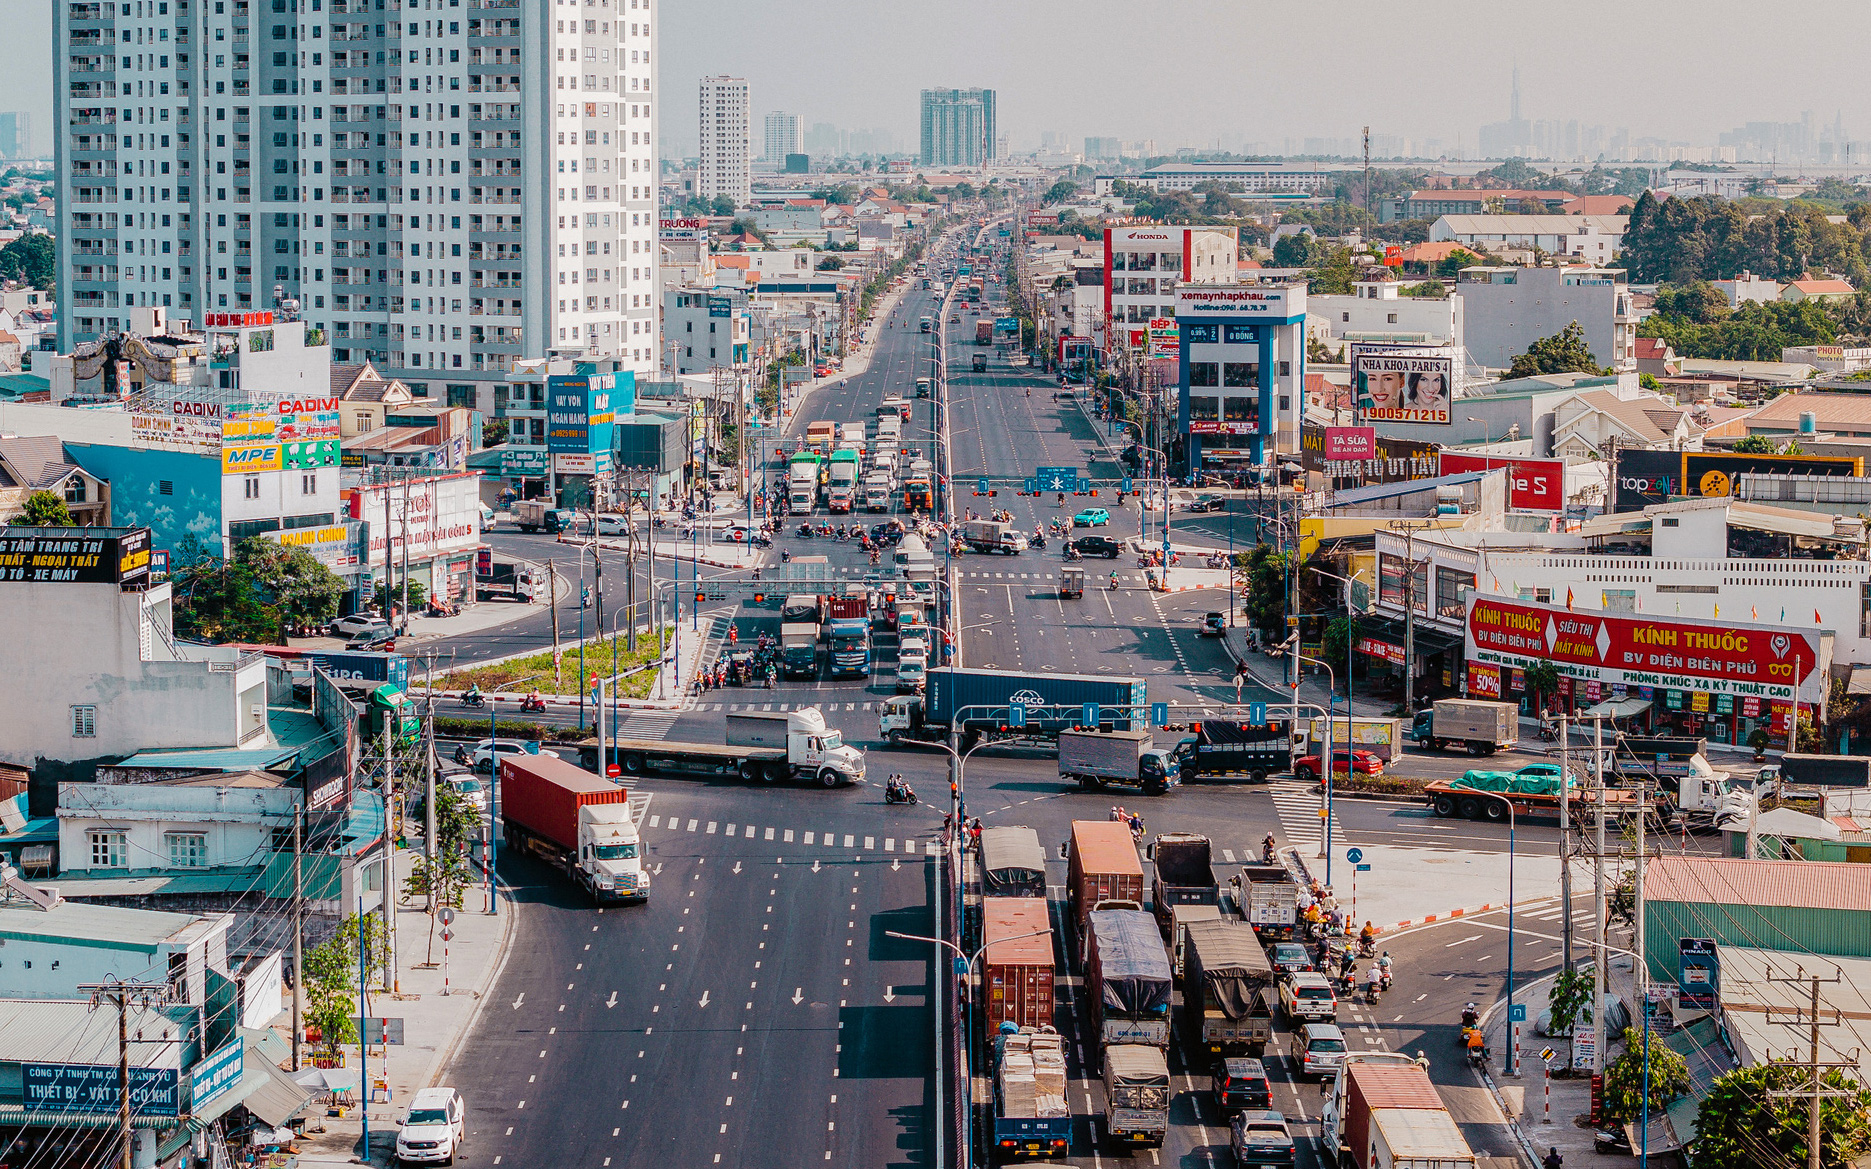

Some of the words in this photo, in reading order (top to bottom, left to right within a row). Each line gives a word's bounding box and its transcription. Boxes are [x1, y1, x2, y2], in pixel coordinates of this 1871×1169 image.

[1181, 291, 1281, 302] xemaynhapkhau.com
[1151, 317, 1170, 329] BẾP
[1236, 331, 1254, 340] ĐỒNG
[1817, 346, 1843, 355] PHOTO
[1362, 360, 1382, 370] NHA
[1384, 360, 1409, 371] KHOA
[1412, 361, 1441, 372] PARI'S
[1442, 362, 1448, 372] 4
[588, 376, 601, 391] VAY
[602, 373, 616, 390] TIỀN
[279, 397, 340, 414] CADIVI
[556, 395, 566, 407] VAY
[173, 401, 220, 418] CADIVI
[550, 410, 568, 424] NGÂN
[1361, 407, 1447, 421] 1900571215
[132, 416, 152, 430] DOANH
[1303, 429, 1323, 451] MẮT
[1332, 435, 1345, 445] TÃ
[1347, 433, 1368, 445] SỮA
[228, 447, 279, 464] MPE
[281, 530, 315, 547] DOANH
[317, 525, 347, 543] CHÍNH
[447, 523, 465, 539] GÒN
[466, 524, 472, 535] 5
[10, 540, 36, 553] TÂM
[38, 541, 80, 553] TRANG
[83, 540, 104, 553] TRÍ
[0, 553, 26, 567] THẤT
[32, 554, 66, 569] NGOẠI
[70, 553, 100, 567] THẤT
[10, 567, 25, 580] TÔ
[34, 569, 50, 580] XE
[51, 567, 79, 581] MÁY
[1475, 605, 1501, 626] KÍNH
[1503, 611, 1542, 633] THUỐC
[1558, 619, 1578, 634] SIÊU
[1579, 622, 1594, 639] THỊ
[1478, 629, 1489, 642] BV
[1490, 630, 1507, 646] ĐIỆN
[1508, 633, 1525, 648] BIÊN
[1527, 635, 1542, 651] PHỦ
[1554, 637, 1573, 654] MẮT
[1573, 641, 1595, 657] KÍNH
[1633, 625, 1678, 647] KÍNH
[1683, 630, 1749, 653] THUỐC
[1477, 651, 1501, 662] CHUYÊN
[1501, 656, 1512, 665] GIA
[1513, 656, 1529, 667] KÍNH
[1578, 667, 1585, 677] SỈ
[1585, 670, 1591, 678] &
[1591, 667, 1600, 679] LẺ
[1623, 652, 1644, 664] BV
[1649, 653, 1683, 670] ĐIỆN
[1687, 657, 1722, 671] BIÊN
[1726, 659, 1758, 675] PHỦ
[1476, 674, 1499, 693] 50%
[1623, 671, 1659, 685] PHÒNG
[1662, 674, 1691, 688] KHÚC
[1694, 677, 1710, 691] XẠ
[1712, 679, 1729, 691] KỸ
[1731, 682, 1766, 696] THUẬT
[1768, 686, 1791, 698] CAO
[1009, 695, 1045, 705] COSCO
[312, 775, 344, 805] SHOWROOM
[29, 1066, 52, 1078] CÔNG
[54, 1069, 64, 1078] TY
[66, 1069, 89, 1079] TNHH
[91, 1070, 104, 1079] TM
[137, 1071, 155, 1081] ANH
[29, 1082, 62, 1099] THIẾT
[65, 1085, 77, 1103] BỊ
[89, 1084, 111, 1103] VẬT
[152, 1086, 172, 1103] KHÍ
[270, 1154, 288, 1165] Coffee
